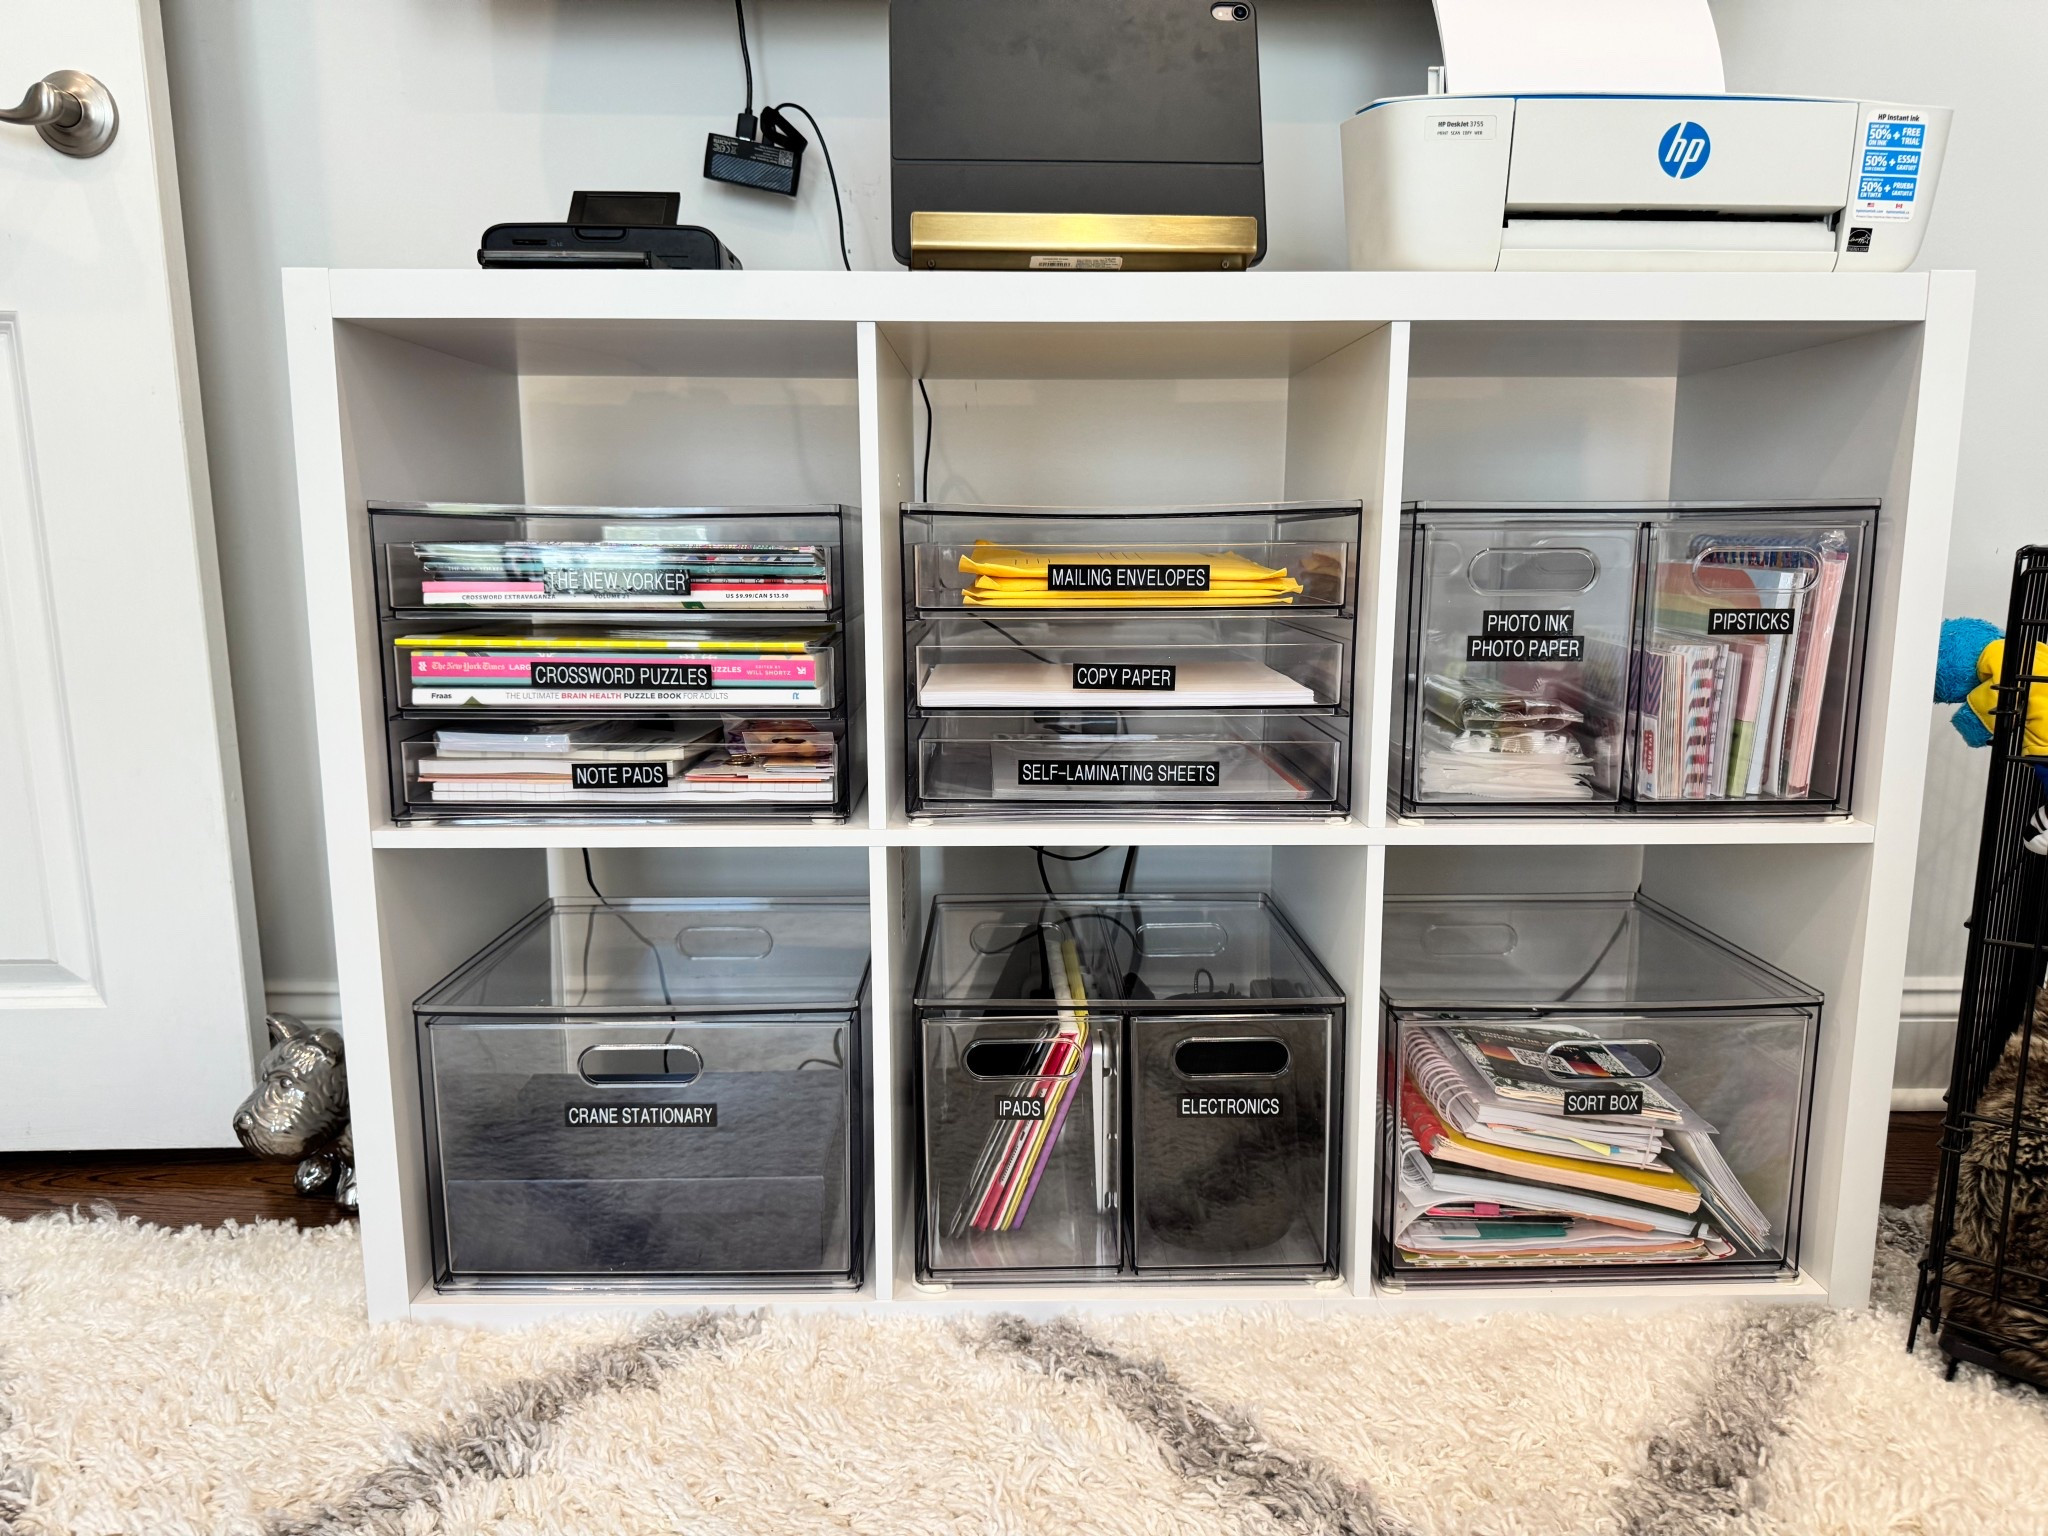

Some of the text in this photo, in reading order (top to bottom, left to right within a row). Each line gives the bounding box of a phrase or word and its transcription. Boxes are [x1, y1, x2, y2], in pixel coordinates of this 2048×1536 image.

[1470, 120, 1484, 128] 3755
[1902, 128, 1921, 136] FREE
[1869, 129, 1891, 139] 50%
[1664, 123, 1706, 178] hp
[1897, 155, 1918, 163] ESSAI
[1865, 156, 1887, 166] 50%
[1861, 182, 1882, 192] 50%
[548, 571, 686, 591] THE NEW YORKER
[1051, 568, 1206, 586] MAILING ENVELOPES
[1486, 614, 1569, 633] PHOTO INK
[1712, 613, 1791, 630] PIPSTICKS
[1470, 639, 1580, 657] PHOTO PAPER
[431, 661, 446, 671] The
[446, 661, 463, 671] New
[463, 661, 482, 672] York
[482, 661, 505, 671] Times
[534, 666, 708, 685] CROSSWORD PUZZLES
[1077, 667, 1172, 686] COPY PAPER
[699, 692, 729, 700] ADULTS
[576, 766, 664, 784] NOTE PADS
[1022, 763, 1216, 782] SELF-LAMINATING SHEETS
[999, 1100, 1041, 1117] IPADS
[1181, 1098, 1280, 1115] ELECTRONICS
[1567, 1094, 1639, 1111] SORT BOX
[568, 1107, 713, 1124] CRANE STATIONARY
